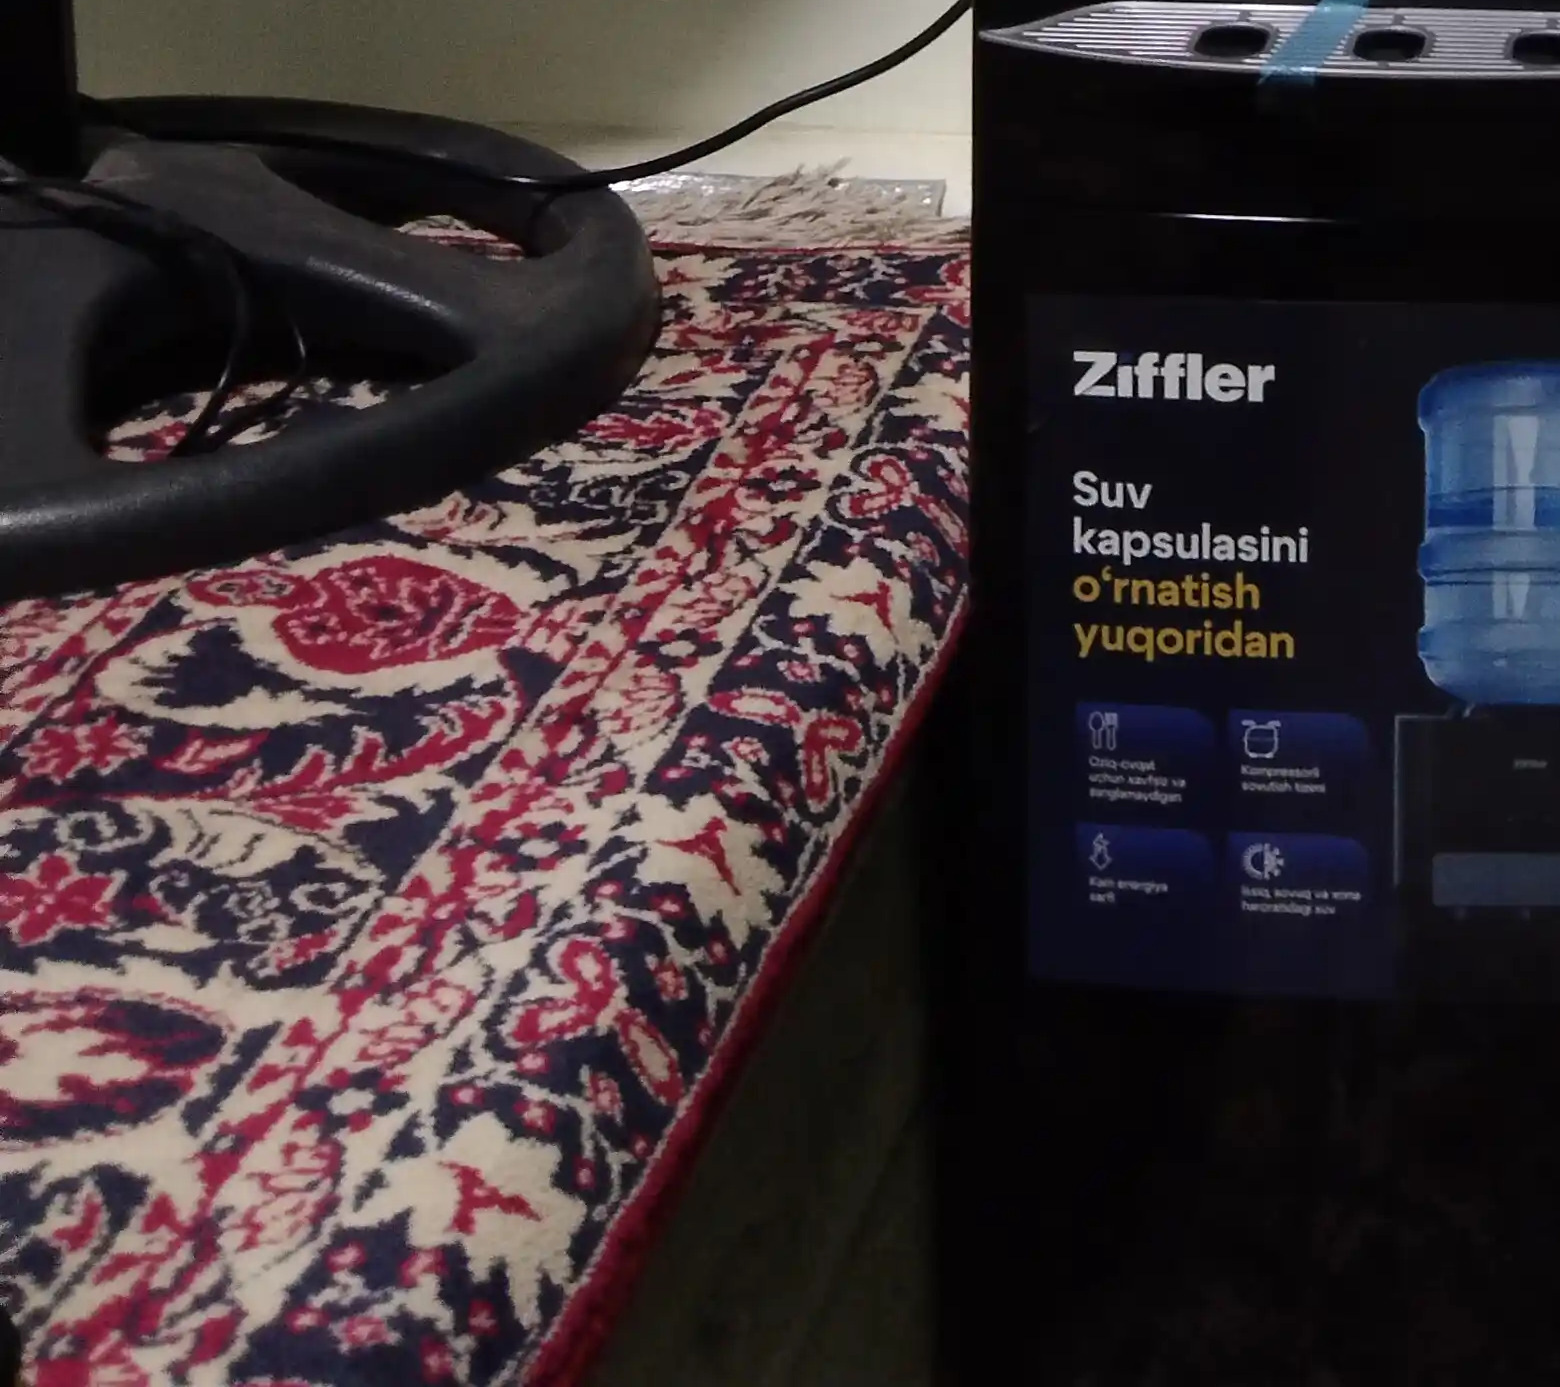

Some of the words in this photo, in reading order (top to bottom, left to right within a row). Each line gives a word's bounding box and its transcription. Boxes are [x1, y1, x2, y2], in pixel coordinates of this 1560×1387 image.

[1073, 350, 1276, 403] Ziffler
[1073, 471, 1153, 510] Suv
[1073, 516, 1309, 565] kapsulasini
[1073, 620, 1295, 661] yuqoridan
